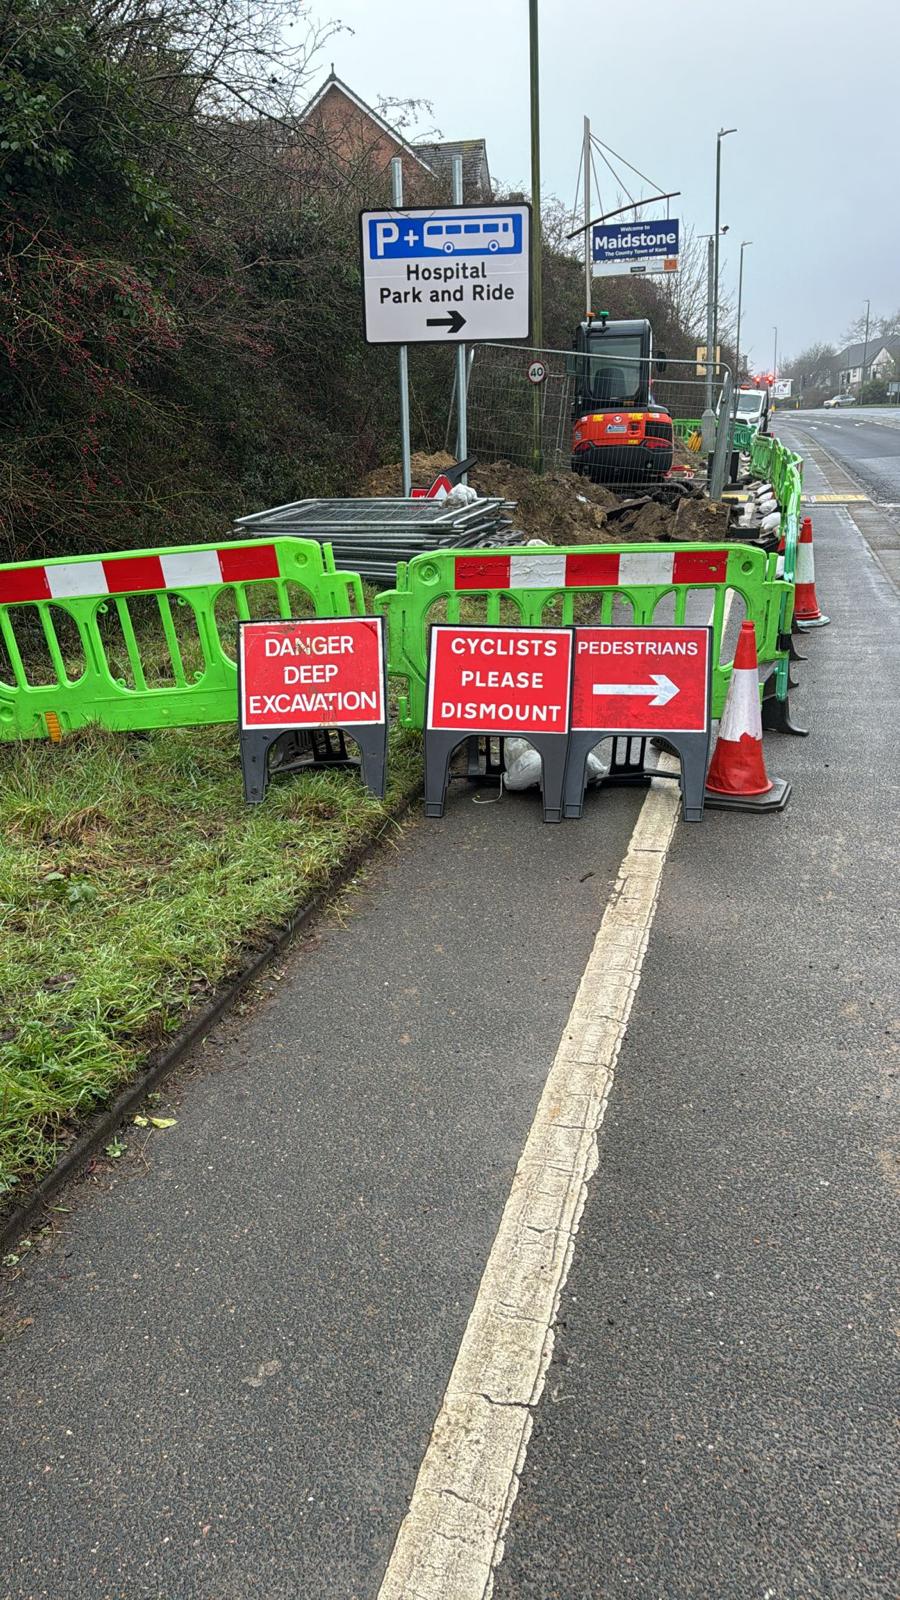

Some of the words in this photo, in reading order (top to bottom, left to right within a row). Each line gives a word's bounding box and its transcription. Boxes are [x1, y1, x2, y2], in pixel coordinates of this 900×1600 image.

[595, 233, 676, 250] Maidstone
[406, 262, 487, 283] Hospital
[380, 287, 422, 304] Park
[430, 285, 464, 303] and
[473, 284, 515, 301] Ride
[530, 367, 544, 377] 40
[265, 636, 354, 657] DANGER
[451, 638, 557, 656] CYCLISTS
[578, 641, 698, 656] PEDESTRIANS
[284, 665, 338, 685] DEEP
[461, 671, 544, 689] PLEASE
[249, 691, 377, 714] EXCAVATION
[441, 702, 561, 722] DISMOUNT
